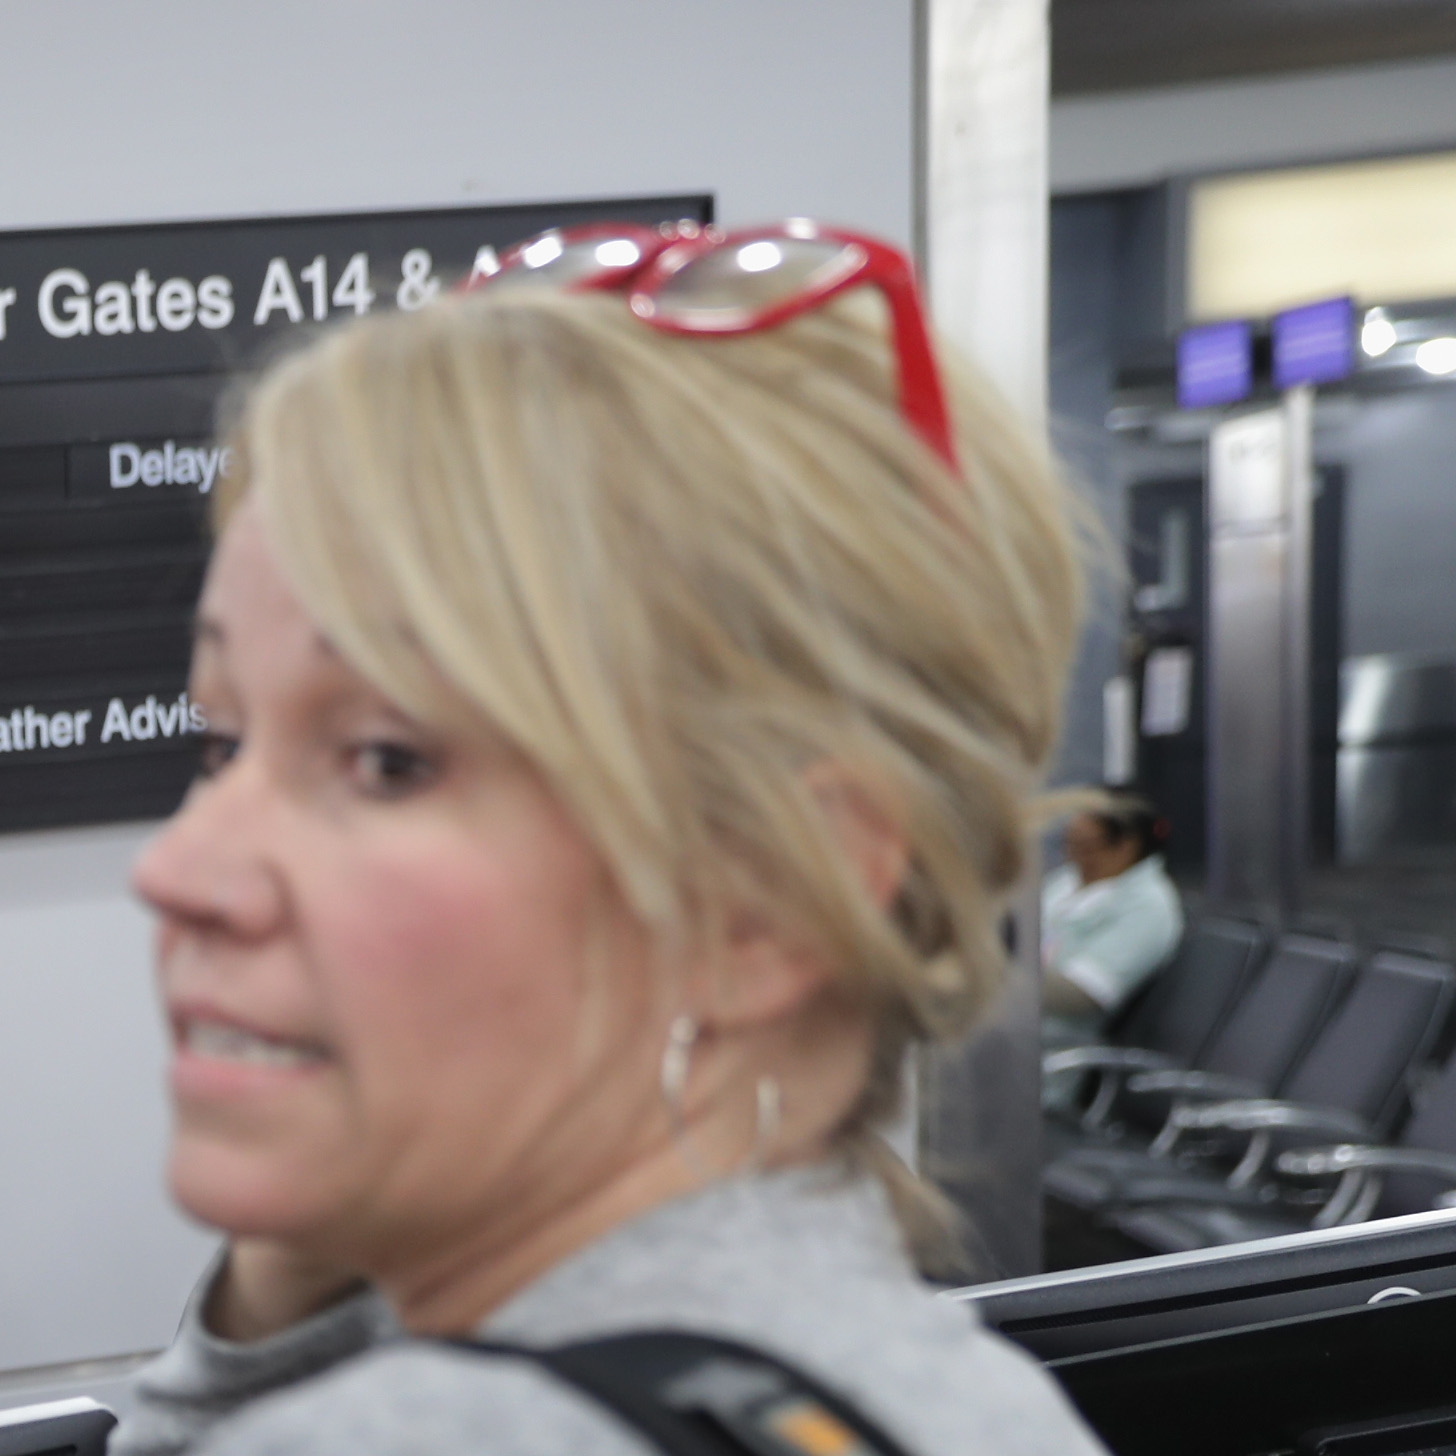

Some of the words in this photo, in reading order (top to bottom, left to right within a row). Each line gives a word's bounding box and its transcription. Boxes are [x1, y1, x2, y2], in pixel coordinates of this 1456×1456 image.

[37, 268, 235, 337] Gates
[253, 253, 374, 325] A14
[396, 248, 441, 311] &
